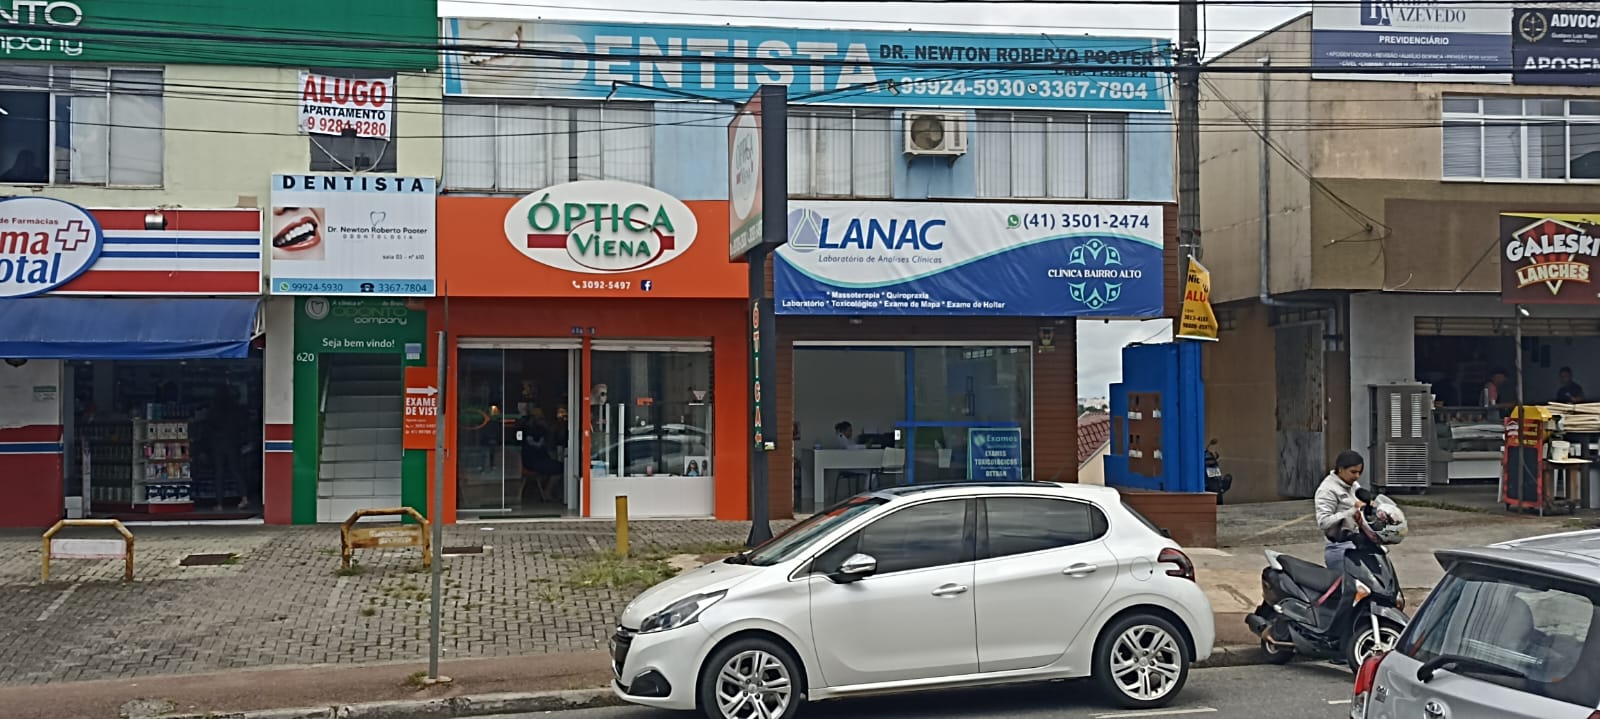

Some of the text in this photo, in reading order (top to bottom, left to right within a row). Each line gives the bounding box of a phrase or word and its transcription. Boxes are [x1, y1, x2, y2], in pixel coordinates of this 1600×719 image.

[880, 44, 909, 59] DR.
[915, 45, 990, 61] NEWTON
[997, 47, 1078, 63] ROBERTO
[547, 34, 882, 94] DENTISTA
[303, 75, 386, 107] ALUGO
[901, 77, 1148, 99] 99924-5930 3367-7804
[303, 104, 386, 120] APARTAMENTO
[283, 176, 424, 192] DENTISTA
[528, 193, 675, 233] ÓPTICA
[1024, 213, 1150, 230] (41) 3501-2474
[819, 218, 946, 250] LANAC
[1506, 234, 1600, 262] GALESKI
[1085, 269, 1117, 278] BAIRRO
[1120, 270, 1141, 278] ALTO
[1517, 264, 1589, 286] LANCHES
[292, 283, 427, 292] 99924-5930 3367-7804
[582, 280, 631, 290] 3092-5497
[831, 291, 929, 300] Massoterapia Quiropraxia
[354, 317, 407, 325] company
[322, 338, 395, 348] Seja bem vindo!
[296, 352, 315, 361] 620
[406, 398, 436, 406] EXAME
[406, 407, 416, 415] DE
